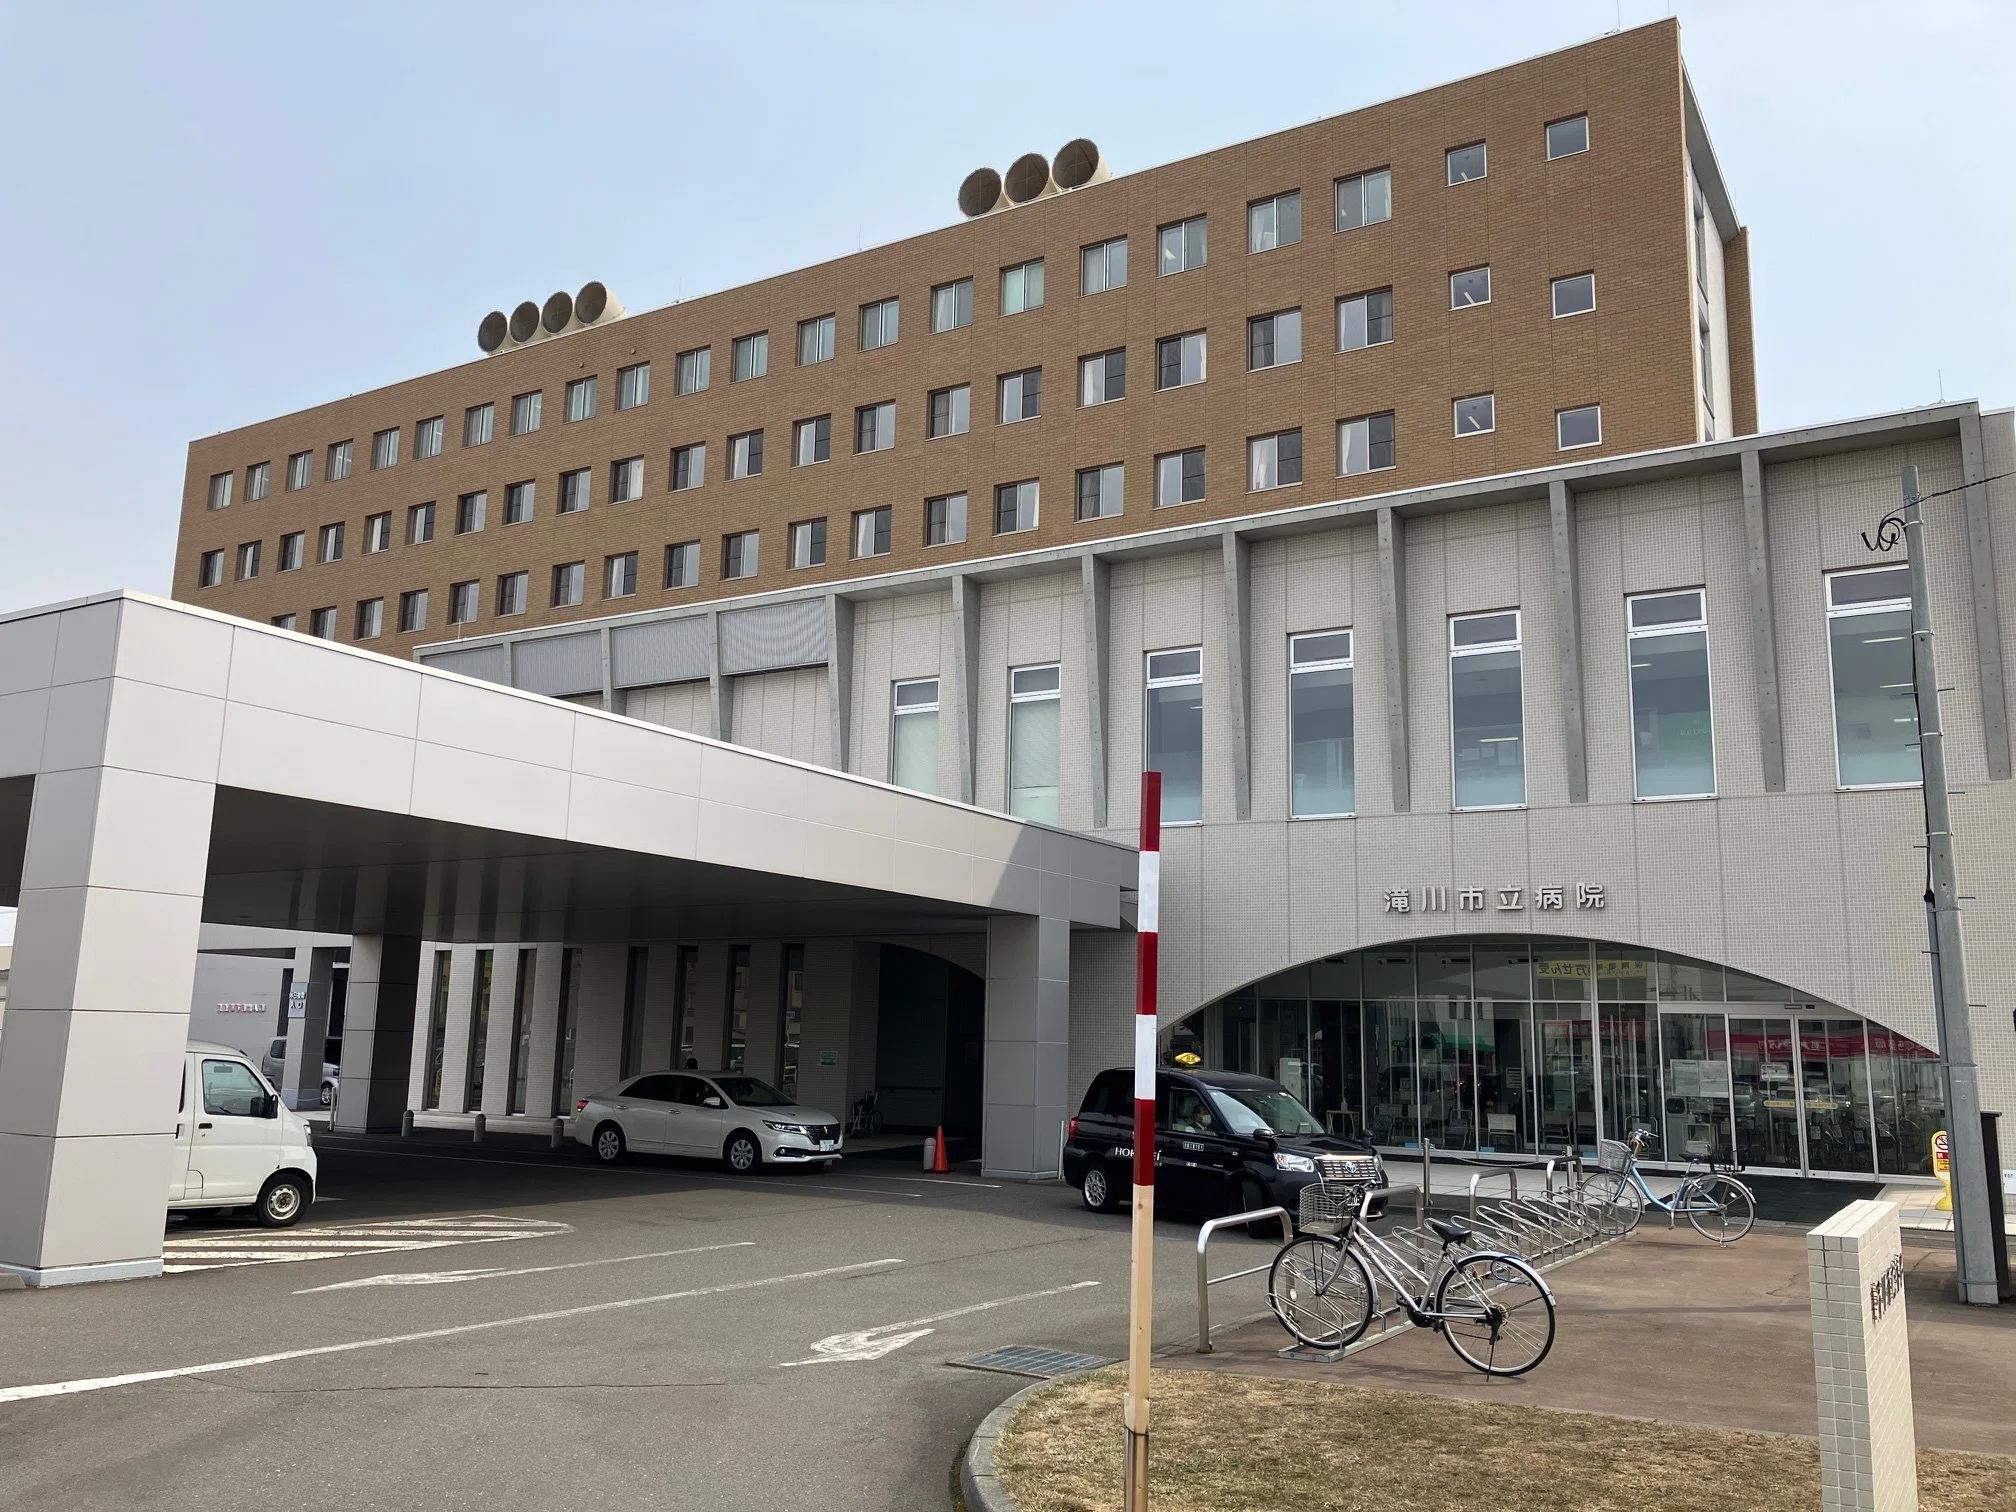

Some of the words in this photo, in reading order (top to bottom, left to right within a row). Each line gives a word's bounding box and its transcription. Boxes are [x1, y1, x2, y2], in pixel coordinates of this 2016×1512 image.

[1384, 881, 1606, 914] 滝川市立病院
[289, 1001, 304, 1010] 入口
